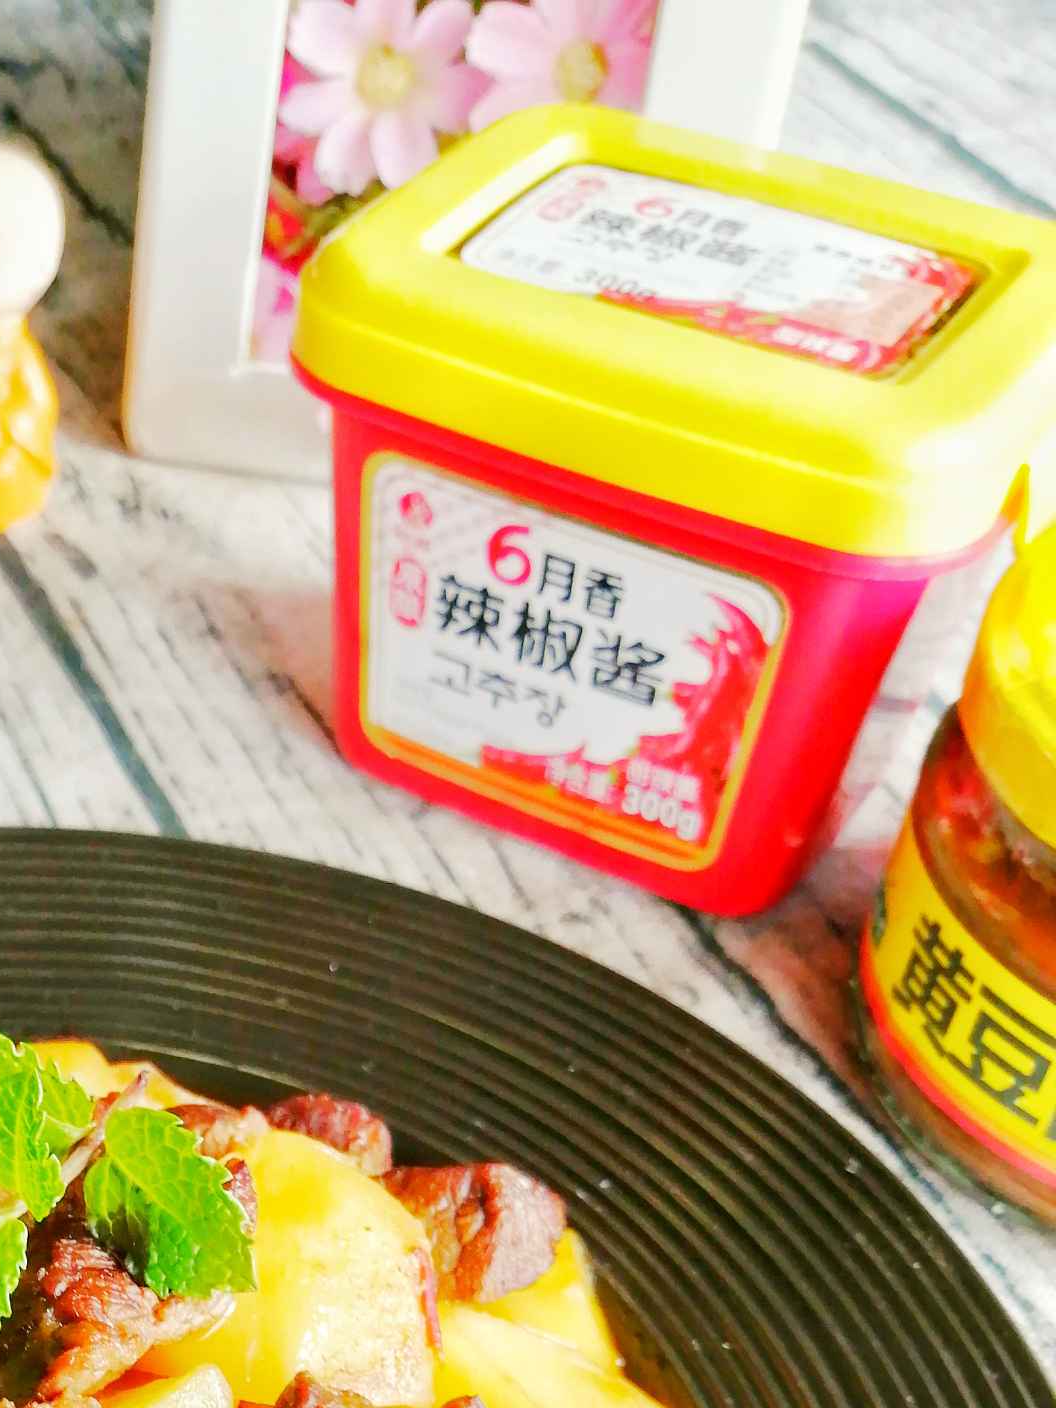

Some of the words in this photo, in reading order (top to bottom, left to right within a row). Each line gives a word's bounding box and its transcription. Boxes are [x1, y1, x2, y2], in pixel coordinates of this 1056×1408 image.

[488, 525, 625, 620] 6月香
[428, 649, 567, 728] 고추장
[436, 574, 666, 707] 辣椒酱
[891, 912, 1056, 1142] 黄豆
